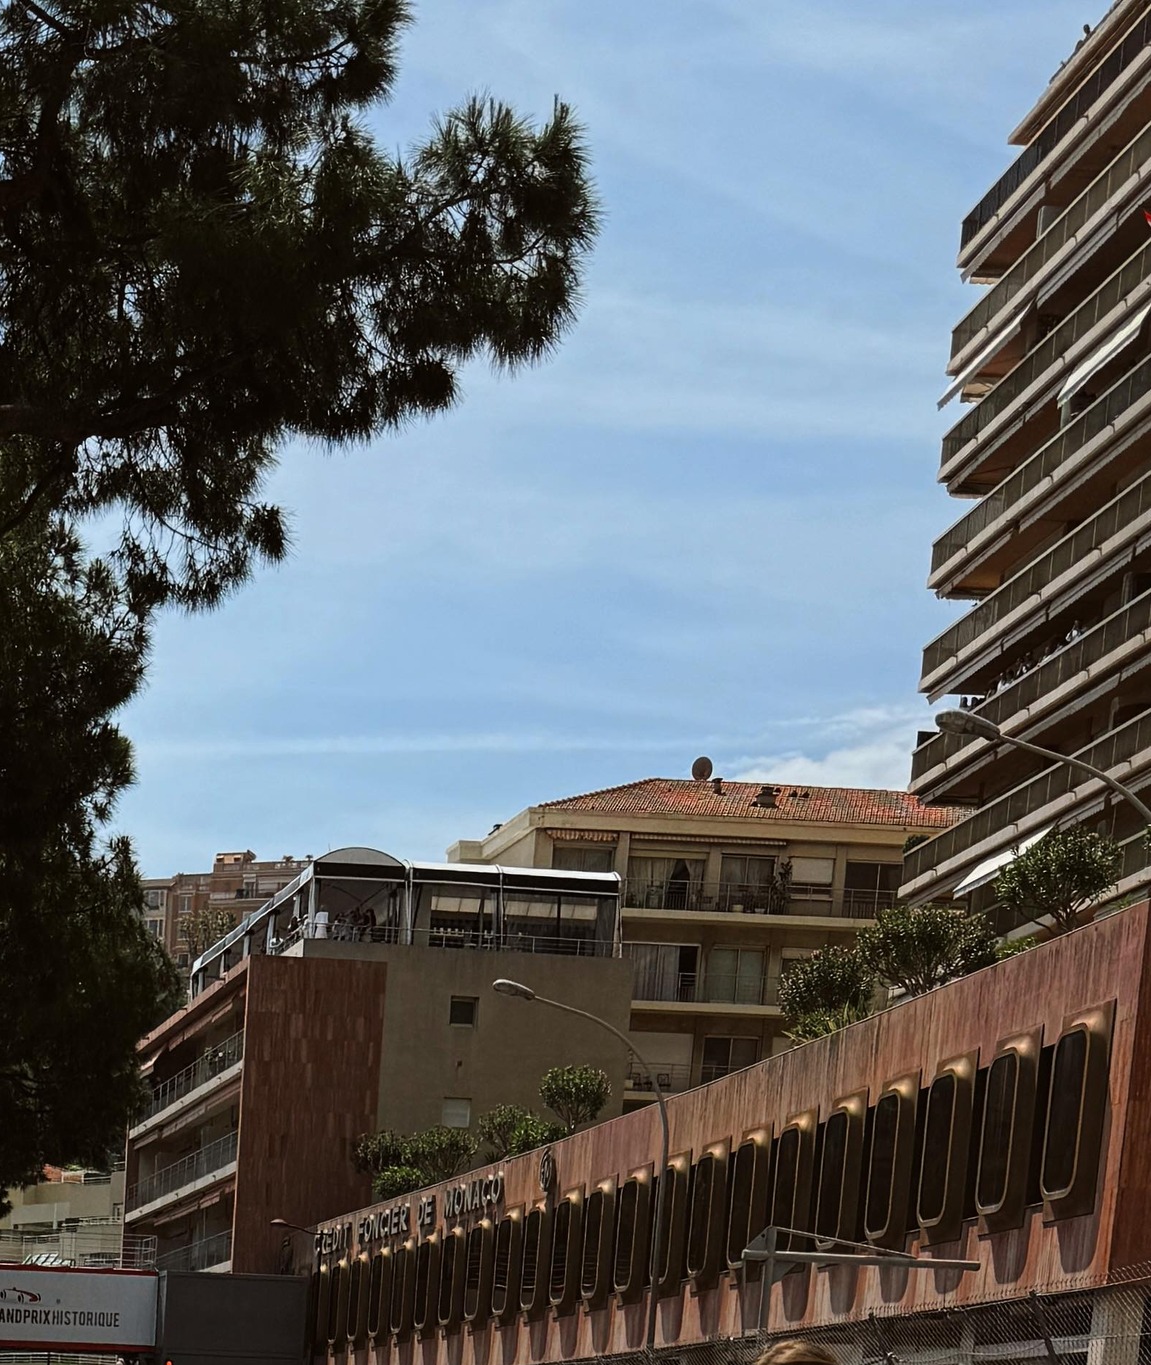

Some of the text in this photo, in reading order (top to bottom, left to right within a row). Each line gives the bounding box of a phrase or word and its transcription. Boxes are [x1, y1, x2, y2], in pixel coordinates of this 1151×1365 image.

[359, 1203, 409, 1243] FONCIER
[417, 1196, 435, 1226] DE
[445, 1176, 500, 1219] MONACO
